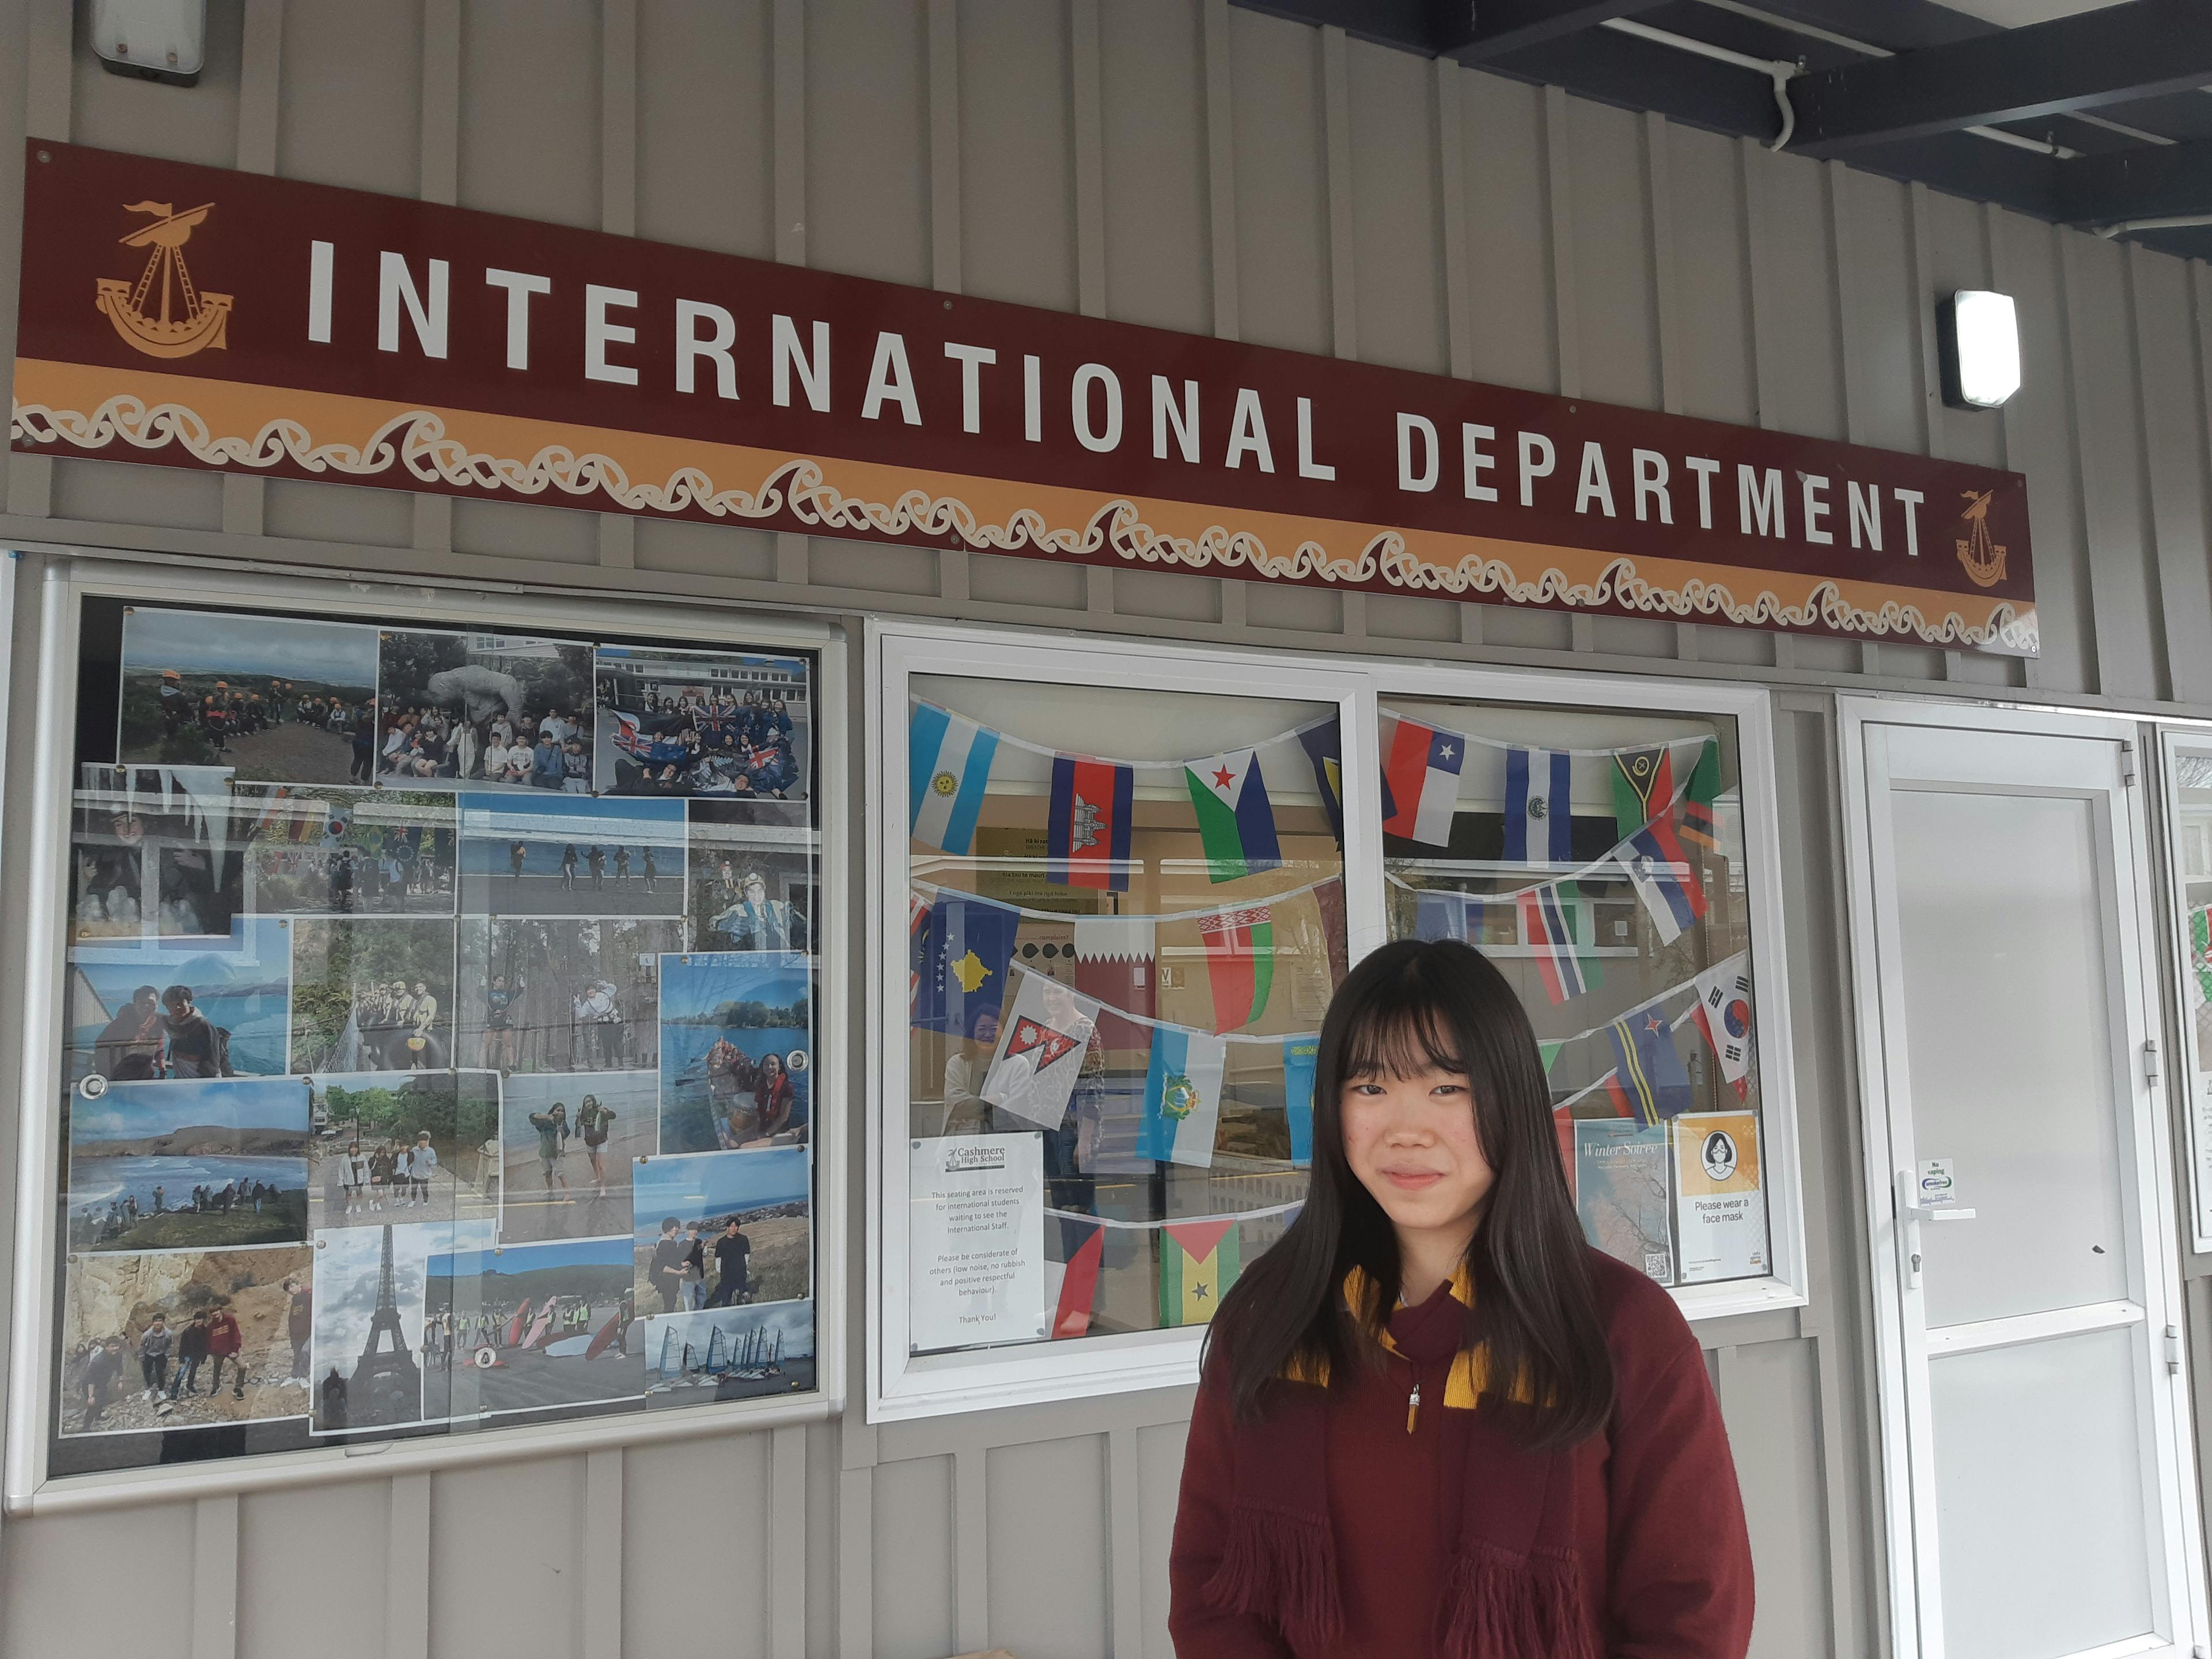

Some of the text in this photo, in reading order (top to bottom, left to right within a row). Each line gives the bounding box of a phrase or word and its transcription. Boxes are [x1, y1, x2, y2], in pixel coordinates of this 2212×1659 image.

[308, 240, 1924, 556] INTERNATIONAL DEPARTMENT
[957, 1146, 1005, 1157] Cashmere
[1584, 1142, 1621, 1157] Winter
[961, 1156, 978, 1164] High
[980, 1154, 1004, 1162] School
[947, 1190, 970, 1198] seating
[995, 1185, 1024, 1194] reserved
[948, 1200, 990, 1210] international
[991, 1198, 1020, 1207] students
[1695, 1200, 1721, 1211] Please
[1723, 1199, 1742, 1209] wear
[949, 1214, 973, 1222] waiting
[1702, 1210, 1743, 1224] face mask
[948, 1222, 1009, 1234] International Staff.
[971, 1249, 1010, 1260] considerate
[1011, 1248, 1018, 1256] of
[953, 1266, 968, 1274] (low
[1001, 1259, 1026, 1268] rubbish
[940, 1272, 1015, 1286] and positive respectful
[959, 1285, 997, 1296] behaviour).
[959, 1313, 996, 1324] Thank You!
